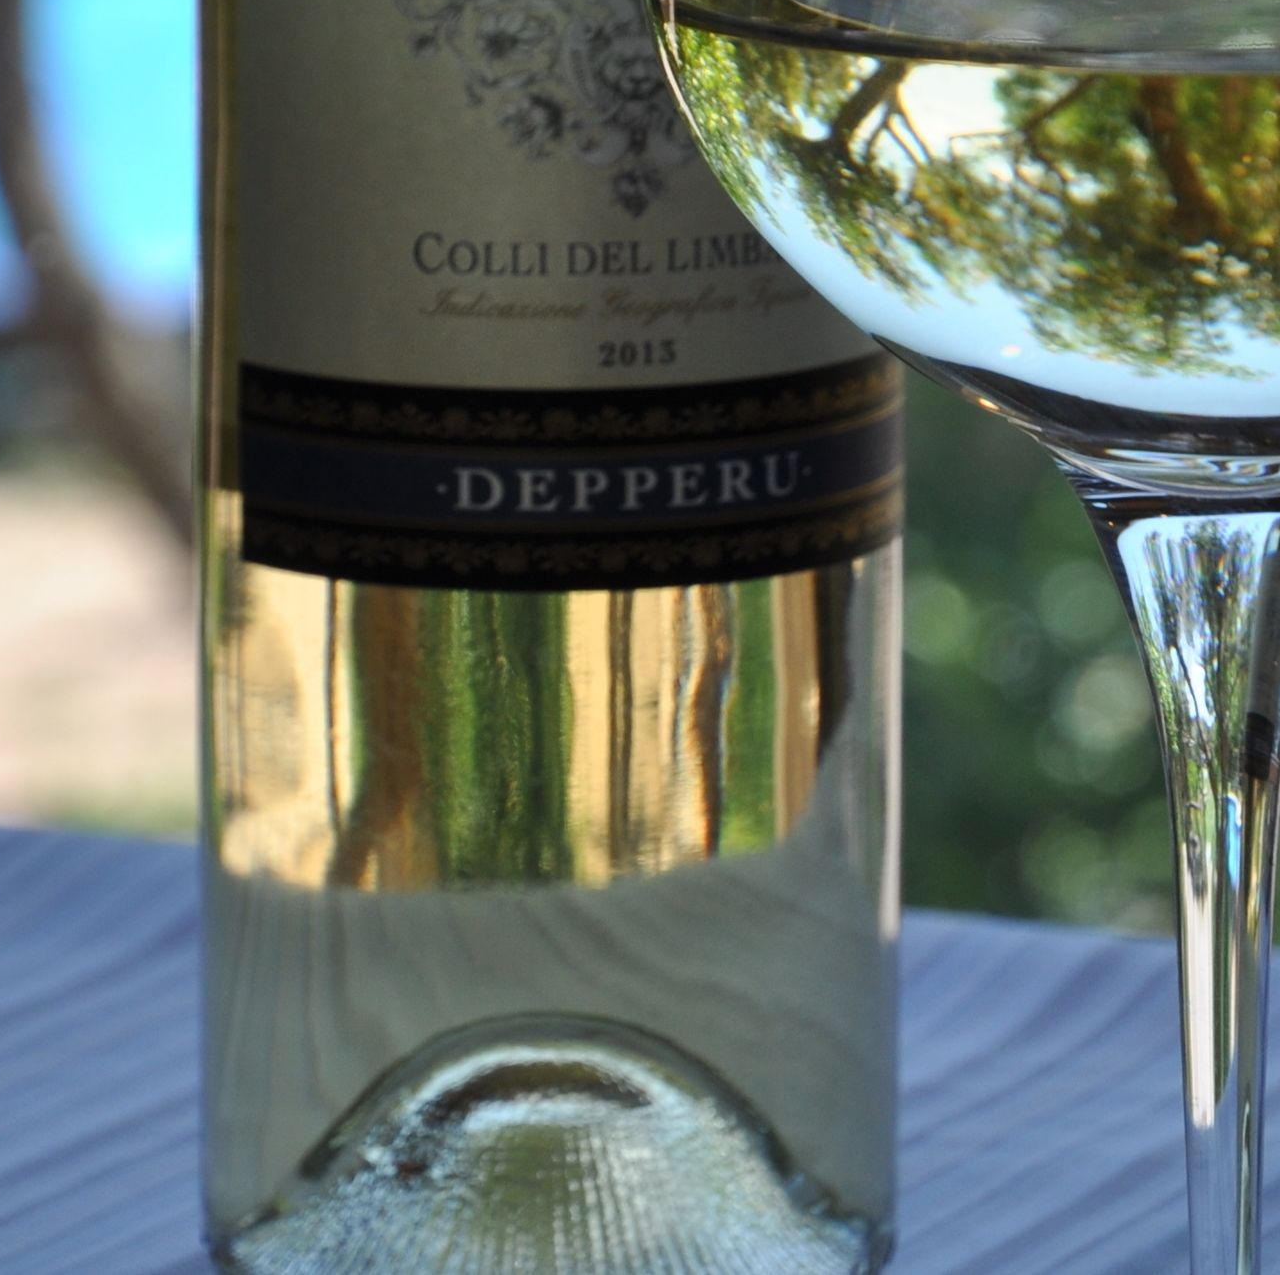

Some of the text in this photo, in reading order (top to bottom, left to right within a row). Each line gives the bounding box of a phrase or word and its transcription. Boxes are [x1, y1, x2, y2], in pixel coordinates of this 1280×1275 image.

[413, 231, 549, 278] COLLI
[567, 239, 653, 276] DEL
[598, 338, 677, 368] 2013
[452, 450, 801, 513] DEPPERU
